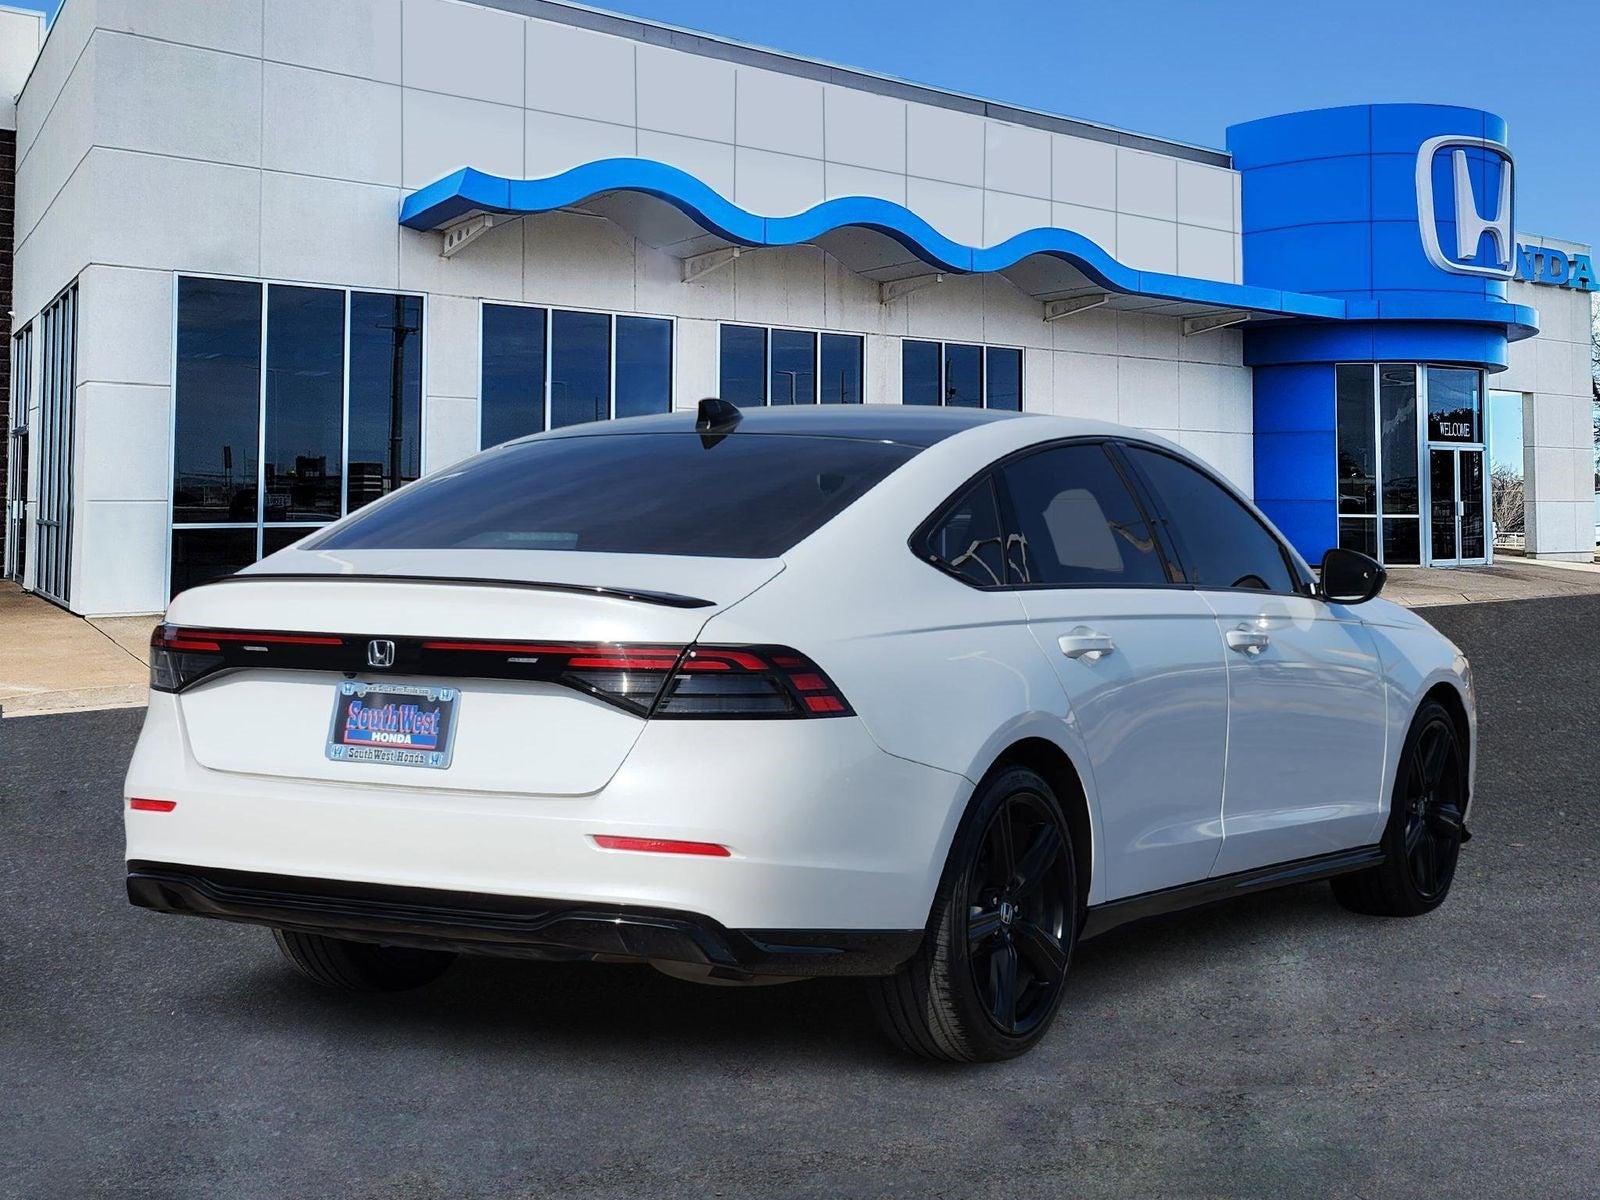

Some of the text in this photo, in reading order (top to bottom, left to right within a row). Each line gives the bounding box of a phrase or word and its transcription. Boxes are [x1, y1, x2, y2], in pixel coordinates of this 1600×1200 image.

[1439, 422, 1471, 437] WELCOME
[371, 732, 412, 744] HONDA
[348, 748, 424, 764] SouthWest Honda
